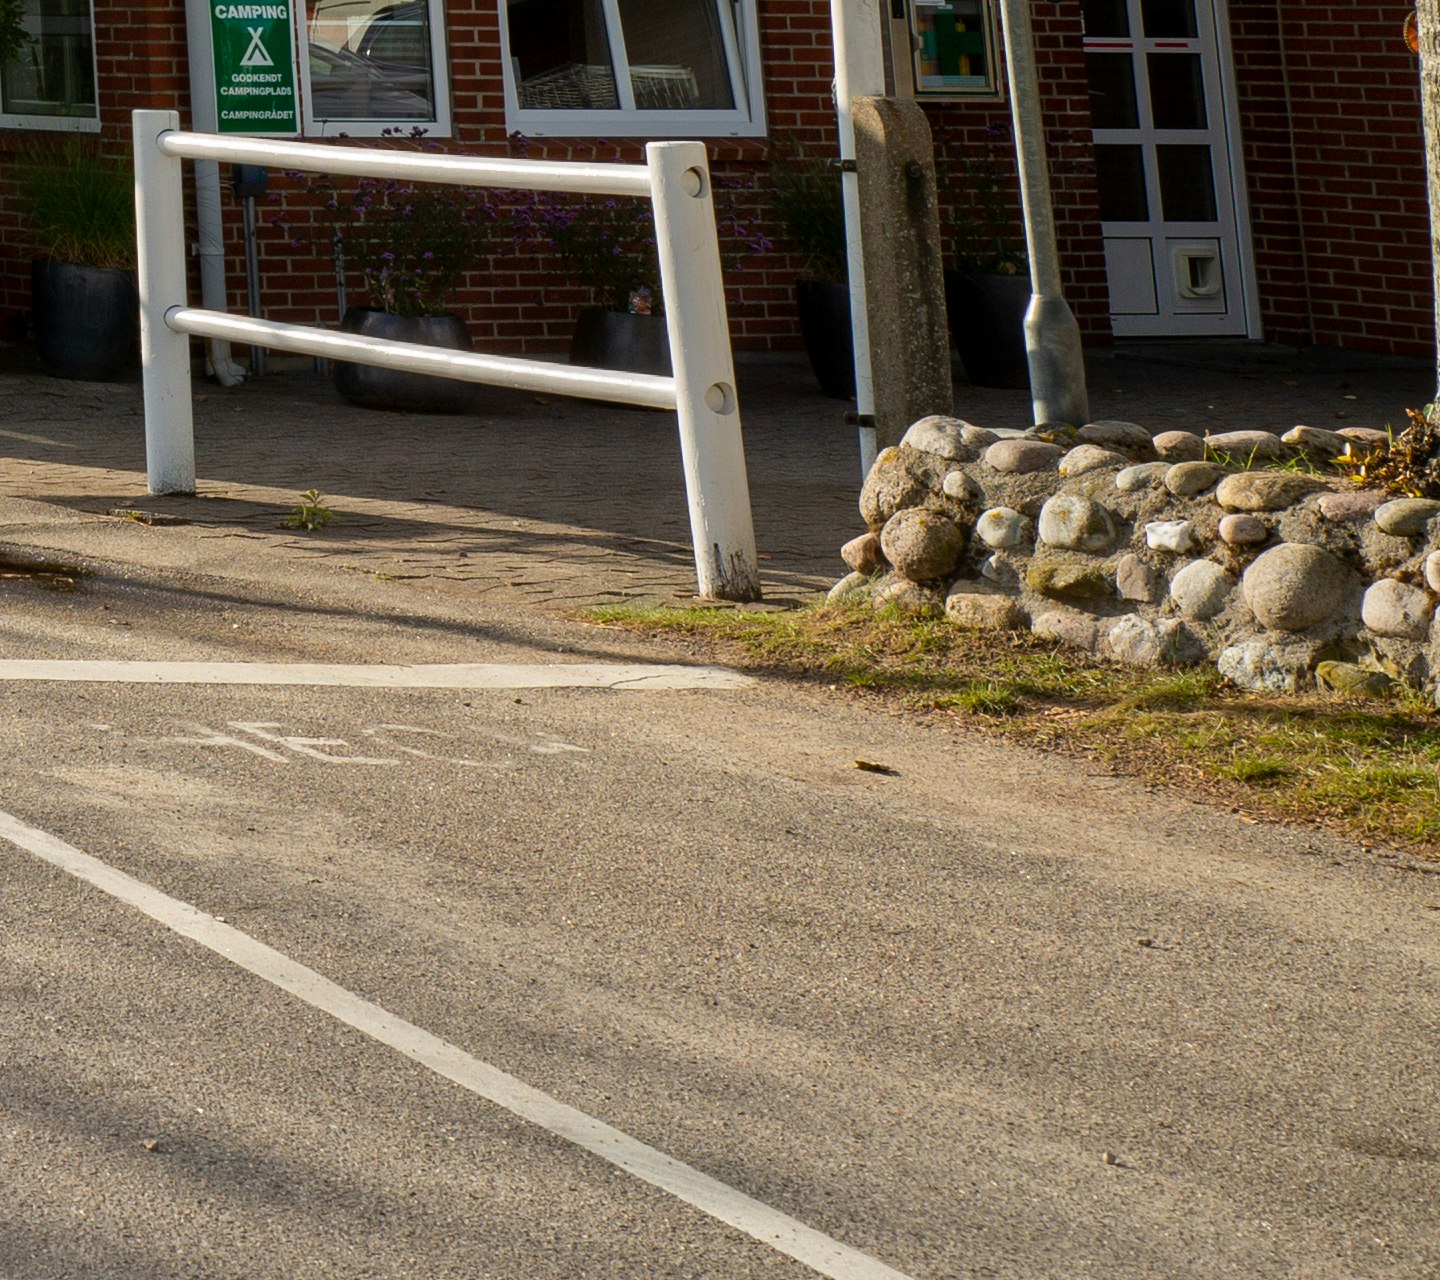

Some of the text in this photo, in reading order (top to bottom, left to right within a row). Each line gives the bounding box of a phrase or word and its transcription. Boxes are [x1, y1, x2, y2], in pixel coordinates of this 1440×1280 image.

[214, 4, 287, 19] CAMPING
[231, 73, 283, 83] GODKENDT
[220, 86, 292, 96] CAMPINGPLADS
